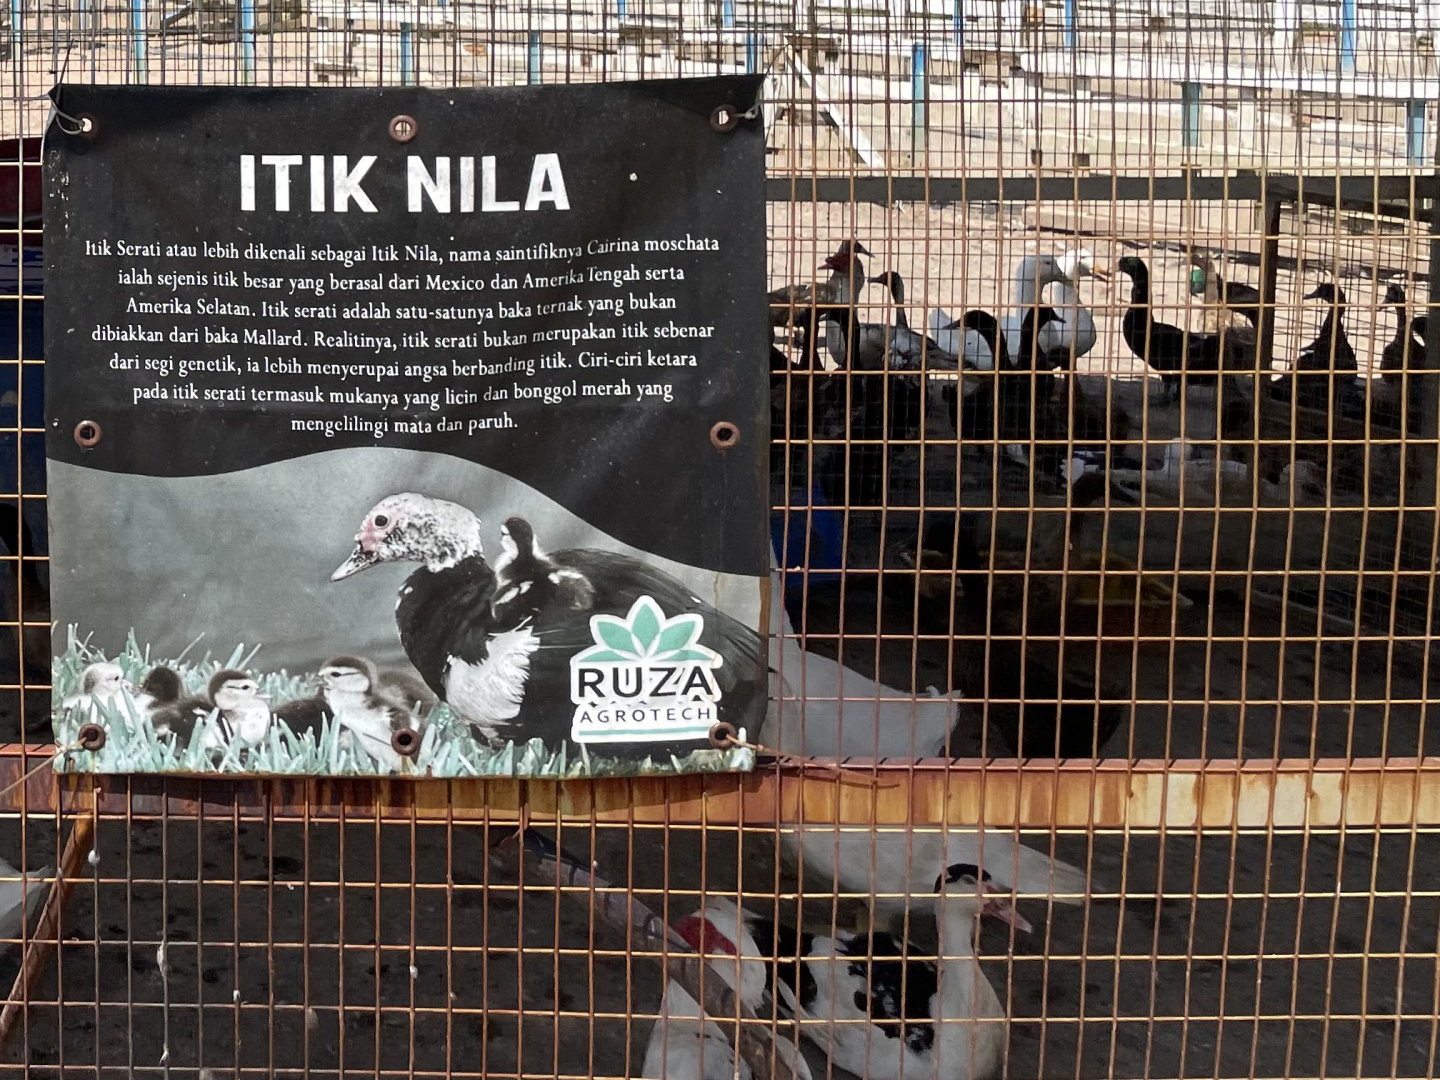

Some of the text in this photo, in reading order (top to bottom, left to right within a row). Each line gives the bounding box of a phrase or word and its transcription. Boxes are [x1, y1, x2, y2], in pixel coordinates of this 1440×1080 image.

[239, 153, 571, 214] ITIK NILA
[86, 234, 719, 267] Itik Serati atau lebih dikenali sebagai Itik Nila, nama saintifiknya Cairina moschata
[119, 264, 684, 296] ialah sejenis itik besar yang berasal dari Mexico dan Amerika Tengah serta
[126, 292, 676, 325] Amerika Selatan. Itik serati adalah satu-satunya baka ternak yang bukan
[92, 321, 714, 353] dibiakkan dari baka Mallard. Realitinya, itik serati bukan merupakan itik sebenar
[110, 349, 697, 382] dari segi genetik, ia lebih menyerupai angsa berbanding itik. Ciri-ciri ketara
[133, 378, 673, 411] pada itik serati termasuk mukanya yang licin dan bonggol merah yang
[291, 412, 518, 438] mengelilingi mata dan paruh.
[577, 667, 714, 698] RUZA
[580, 706, 711, 724] AGROTECH
